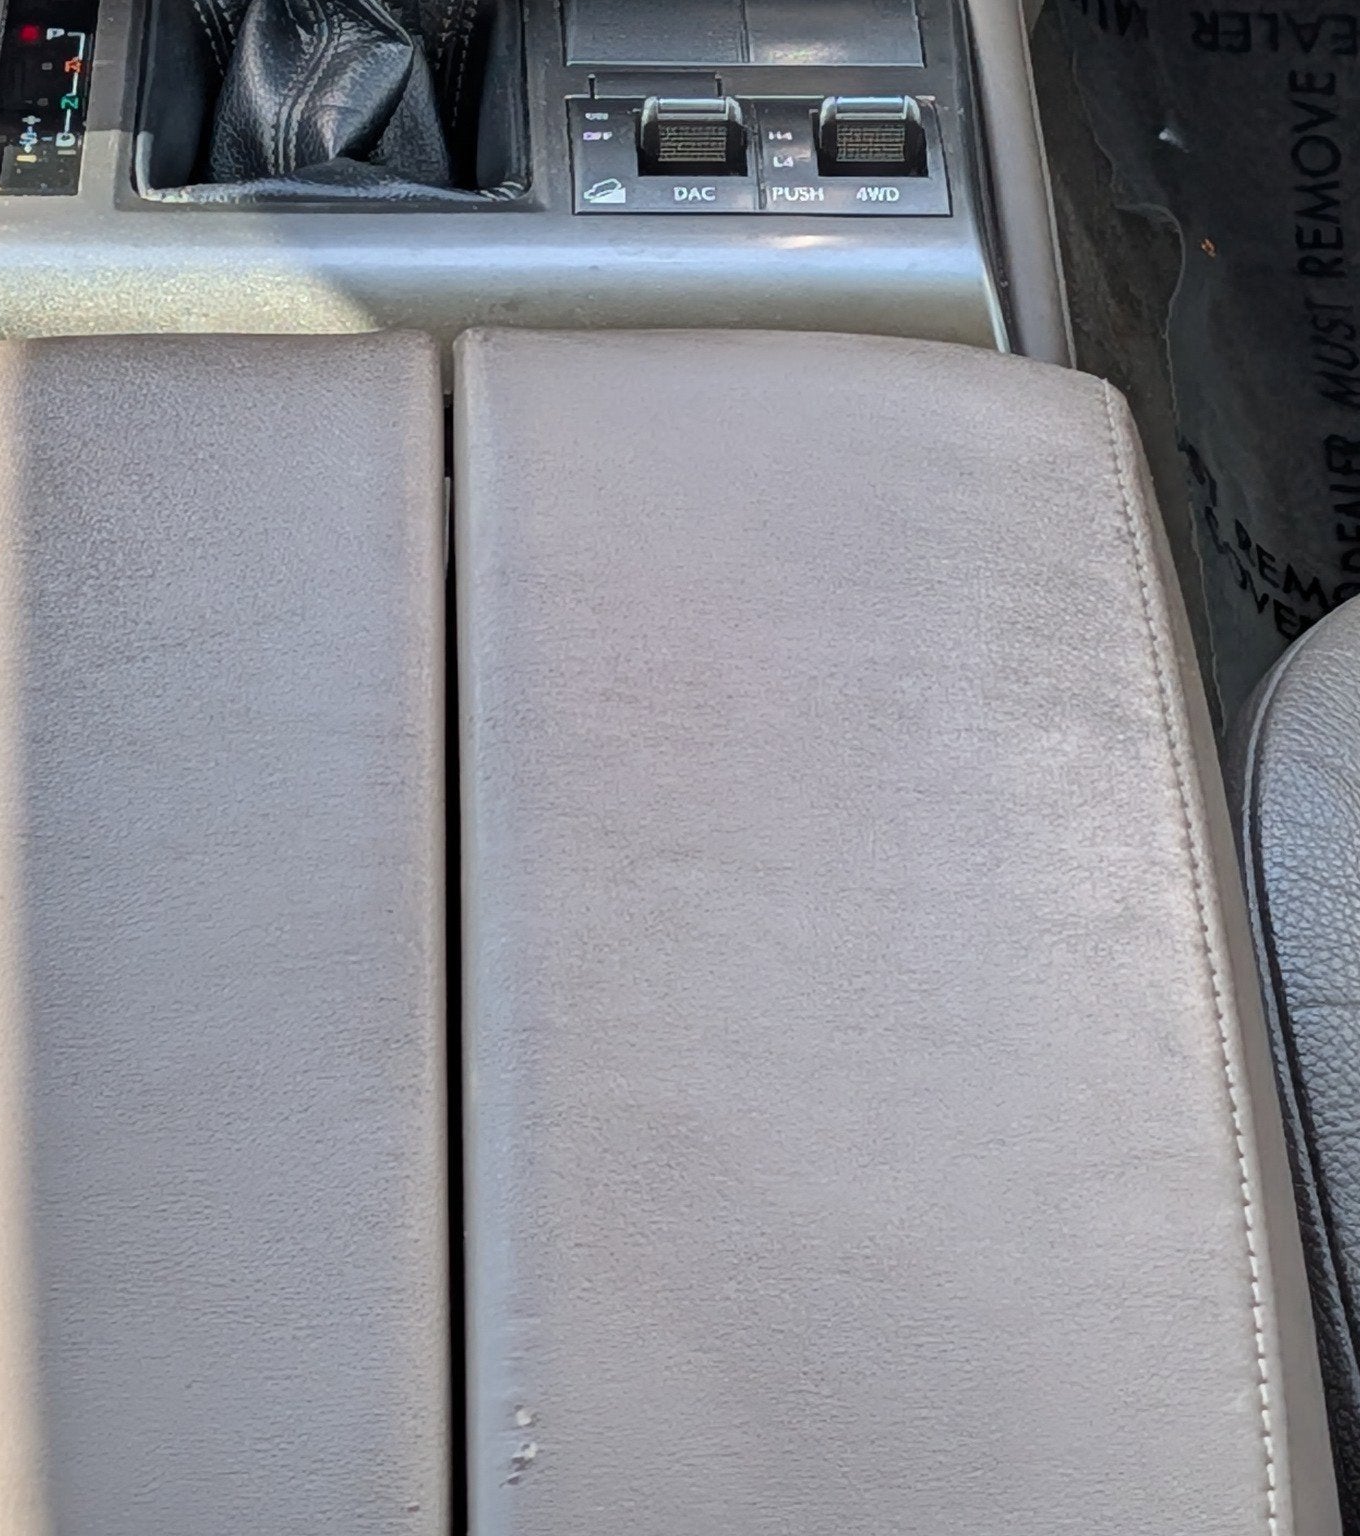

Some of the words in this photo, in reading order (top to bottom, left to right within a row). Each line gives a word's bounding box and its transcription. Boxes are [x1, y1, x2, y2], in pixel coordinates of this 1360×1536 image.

[46, 27, 65, 41] P
[60, 95, 79, 110] N
[773, 155, 794, 168] L4
[1288, 69, 1353, 280] REMOVE
[673, 186, 717, 203] DAC
[772, 186, 825, 203] PUSH
[855, 186, 900, 203] 4WD
